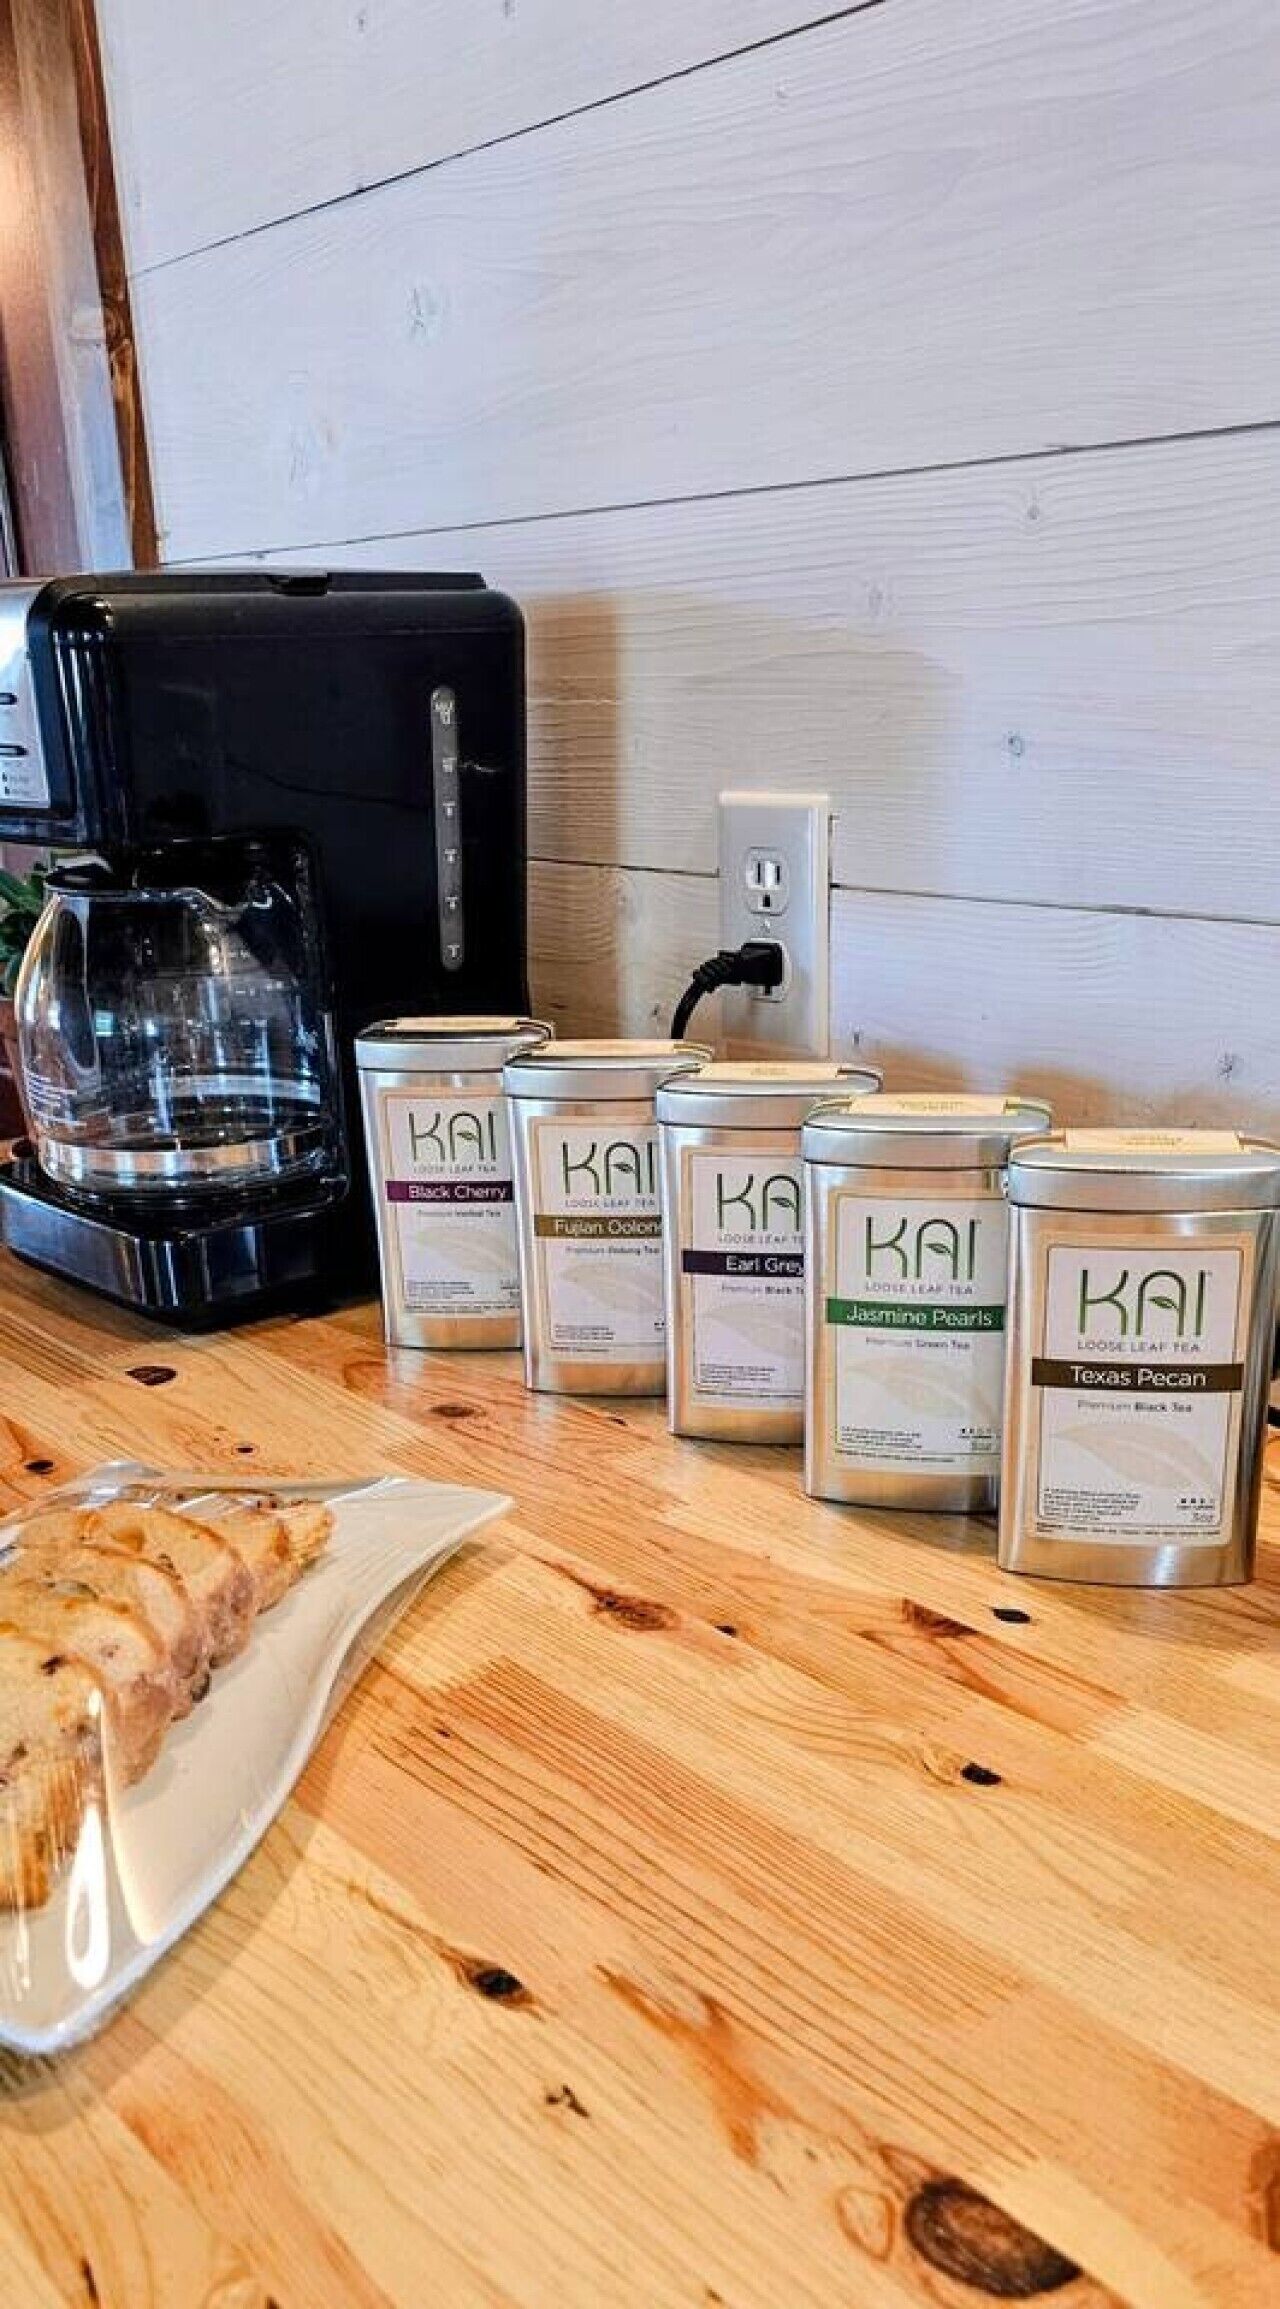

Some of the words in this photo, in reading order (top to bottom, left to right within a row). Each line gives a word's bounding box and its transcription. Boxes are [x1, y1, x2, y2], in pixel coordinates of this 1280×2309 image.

[408, 1110, 496, 1162] KAI
[562, 1141, 655, 1195] KAI
[408, 1184, 450, 1199] Black
[454, 1185, 506, 1202] Cherry
[716, 1173, 800, 1231] KA
[556, 1219, 603, 1237] Fujian
[791, 1235, 804, 1245] TE
[866, 1216, 975, 1280] KAI
[726, 1255, 760, 1272] Earl
[764, 1257, 804, 1277] Grey
[866, 1282, 905, 1293] LOOSE
[911, 1283, 943, 1294] LEAF
[949, 1284, 973, 1295] TEA
[1079, 1269, 1205, 1336] KAI
[847, 1305, 927, 1325] Jasmine
[933, 1308, 992, 1326] Pearls
[1078, 1340, 1122, 1351] LOOSE
[1130, 1341, 1165, 1353] LEAF
[1173, 1341, 1200, 1353] TEA
[1070, 1365, 1132, 1386] Texas
[1138, 1368, 1206, 1387] Pecan
[1135, 1401, 1169, 1413] Black
[1173, 1401, 1192, 1413] Tea
